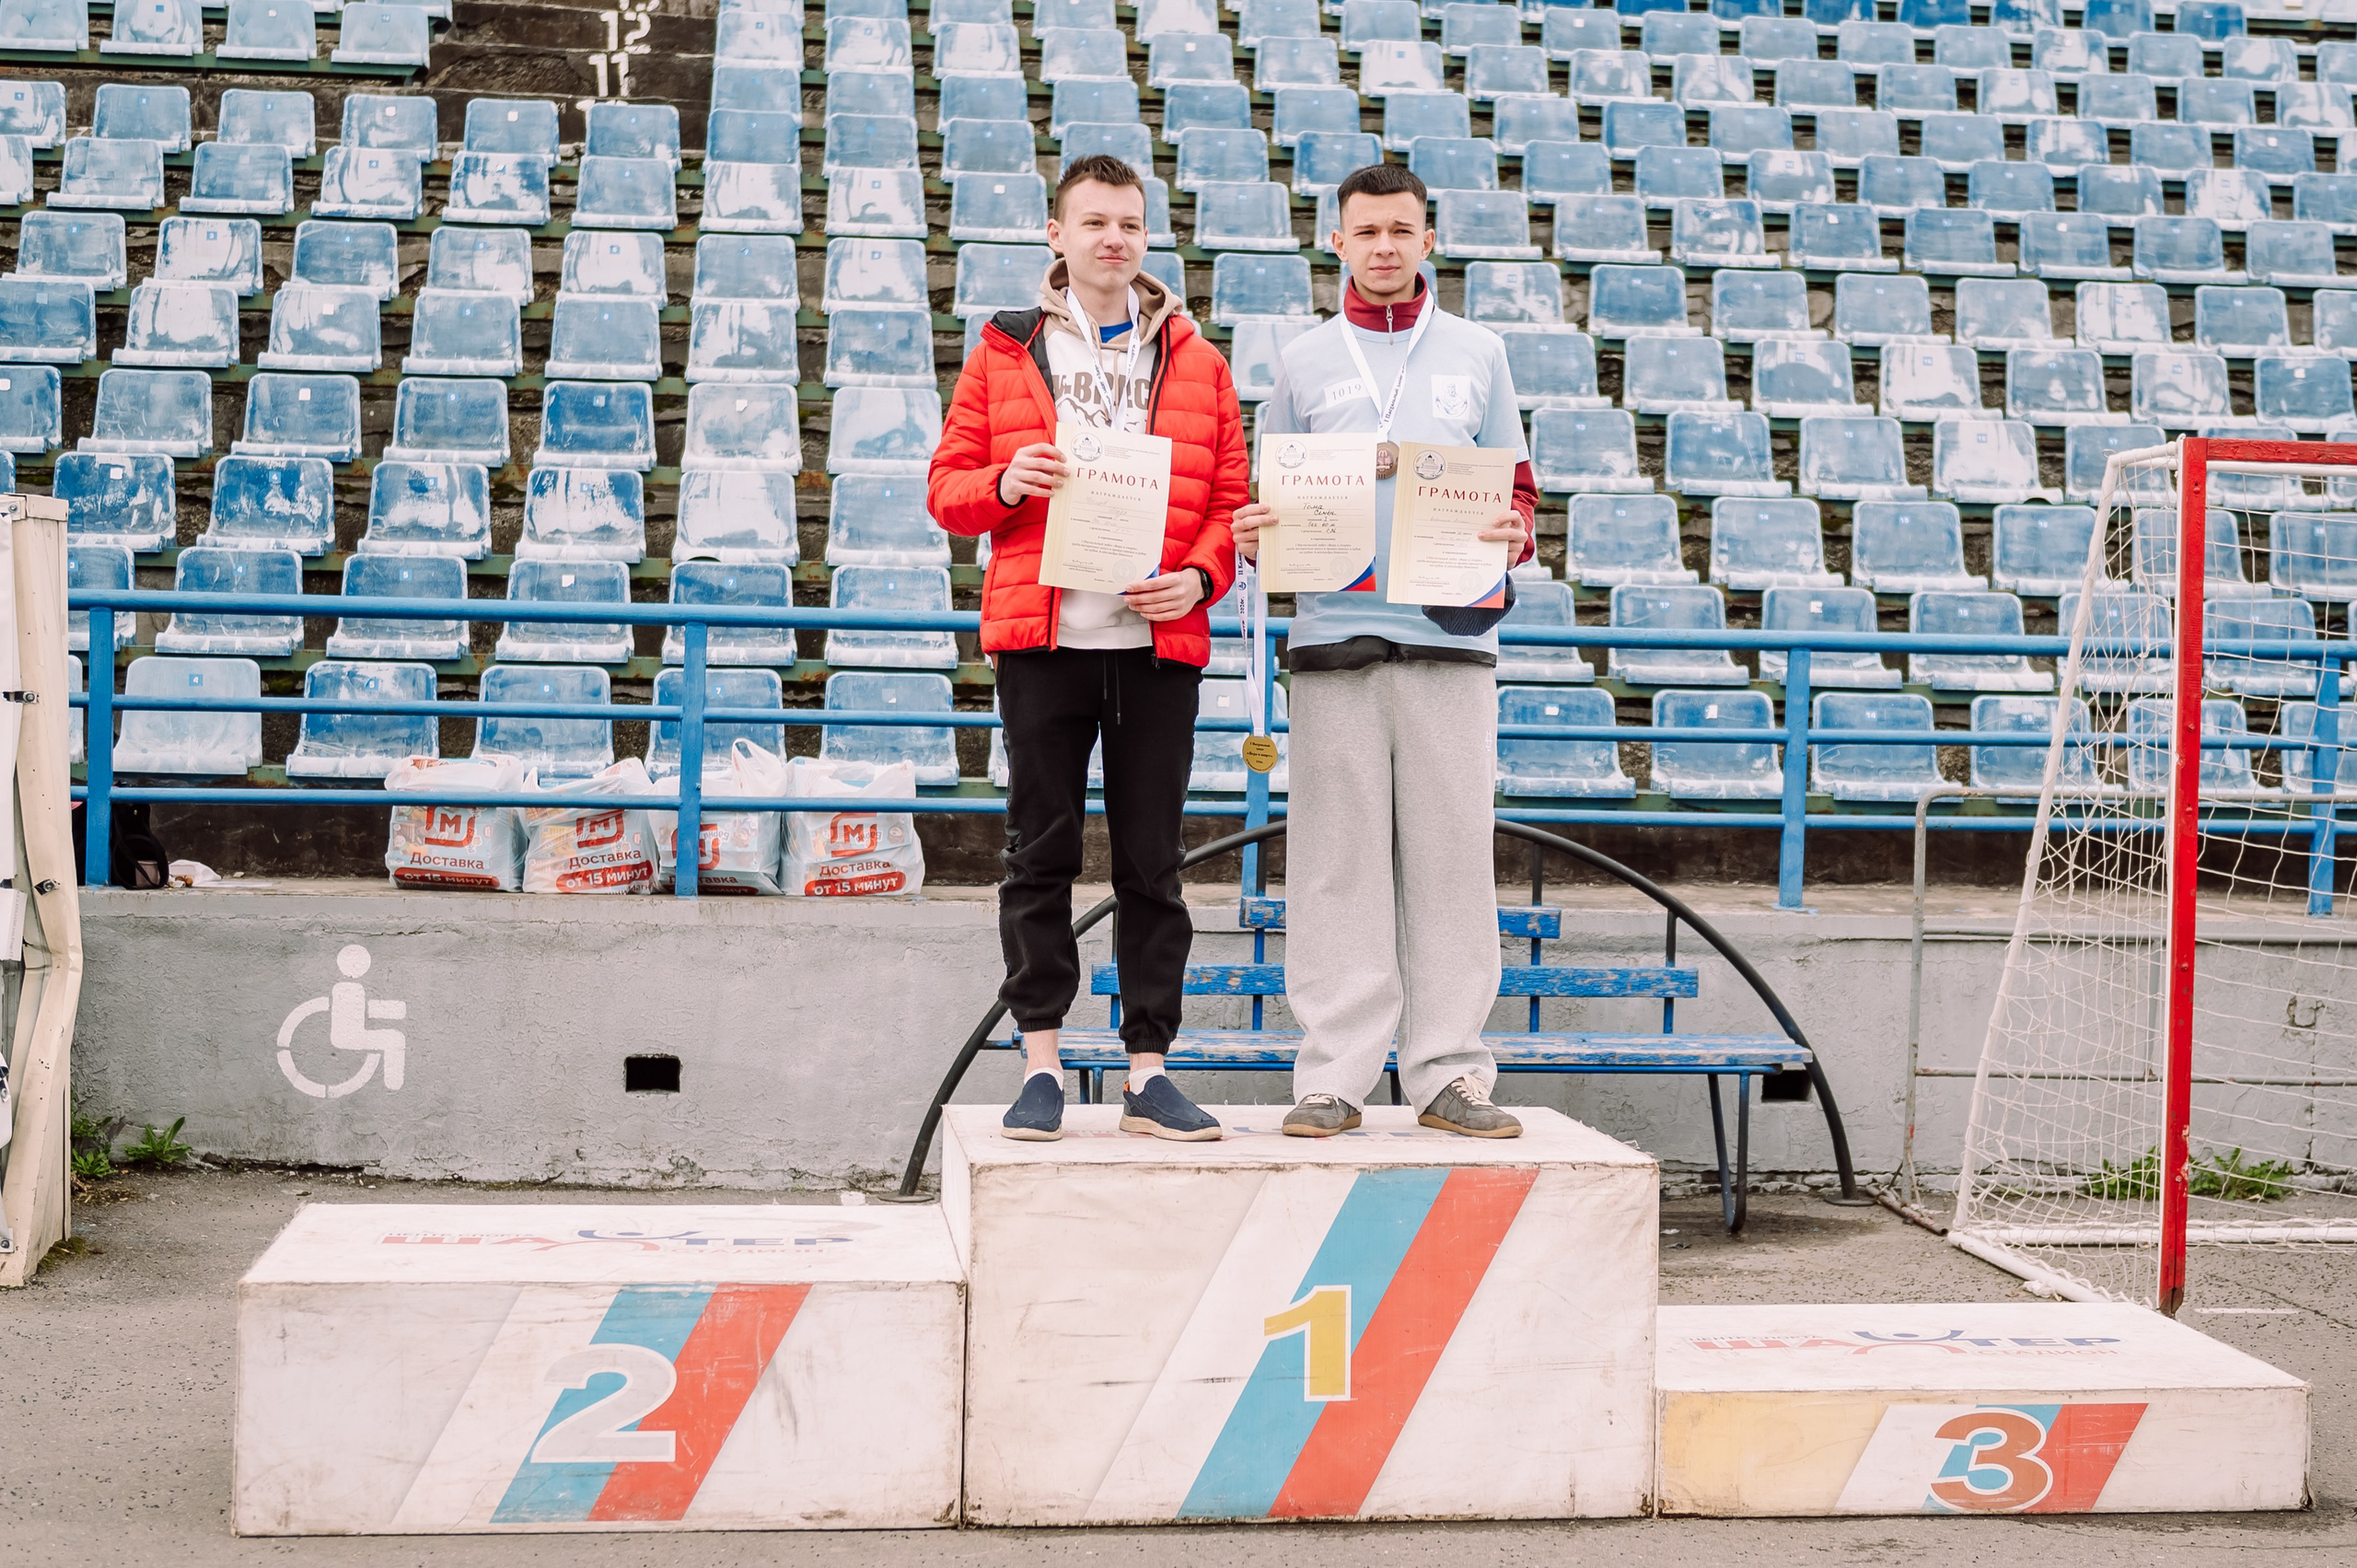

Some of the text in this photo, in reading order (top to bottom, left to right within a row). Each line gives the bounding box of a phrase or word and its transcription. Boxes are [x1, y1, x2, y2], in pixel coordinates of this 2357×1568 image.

[599, 9, 652, 54] 12
[588, 52, 631, 98] 11
[1332, 384, 1362, 401] 1019
[1076, 467, 1158, 491] ГРАМОТА
[1282, 474, 1364, 486] ГРАМОТА
[1418, 486, 1502, 504] ГРАМОТА
[410, 851, 484, 870] Доставка
[569, 849, 642, 869] Доставка
[565, 866, 648, 889] от 15 минут
[819, 861, 891, 877] Доставка
[424, 872, 441, 882] 15
[445, 877, 491, 886] минут
[668, 875, 738, 884] тавка
[814, 877, 899, 896] от 15 минут
[1263, 1284, 1352, 1402] 1
[530, 1342, 679, 1463] 2
[1929, 1408, 2054, 1513] 3
